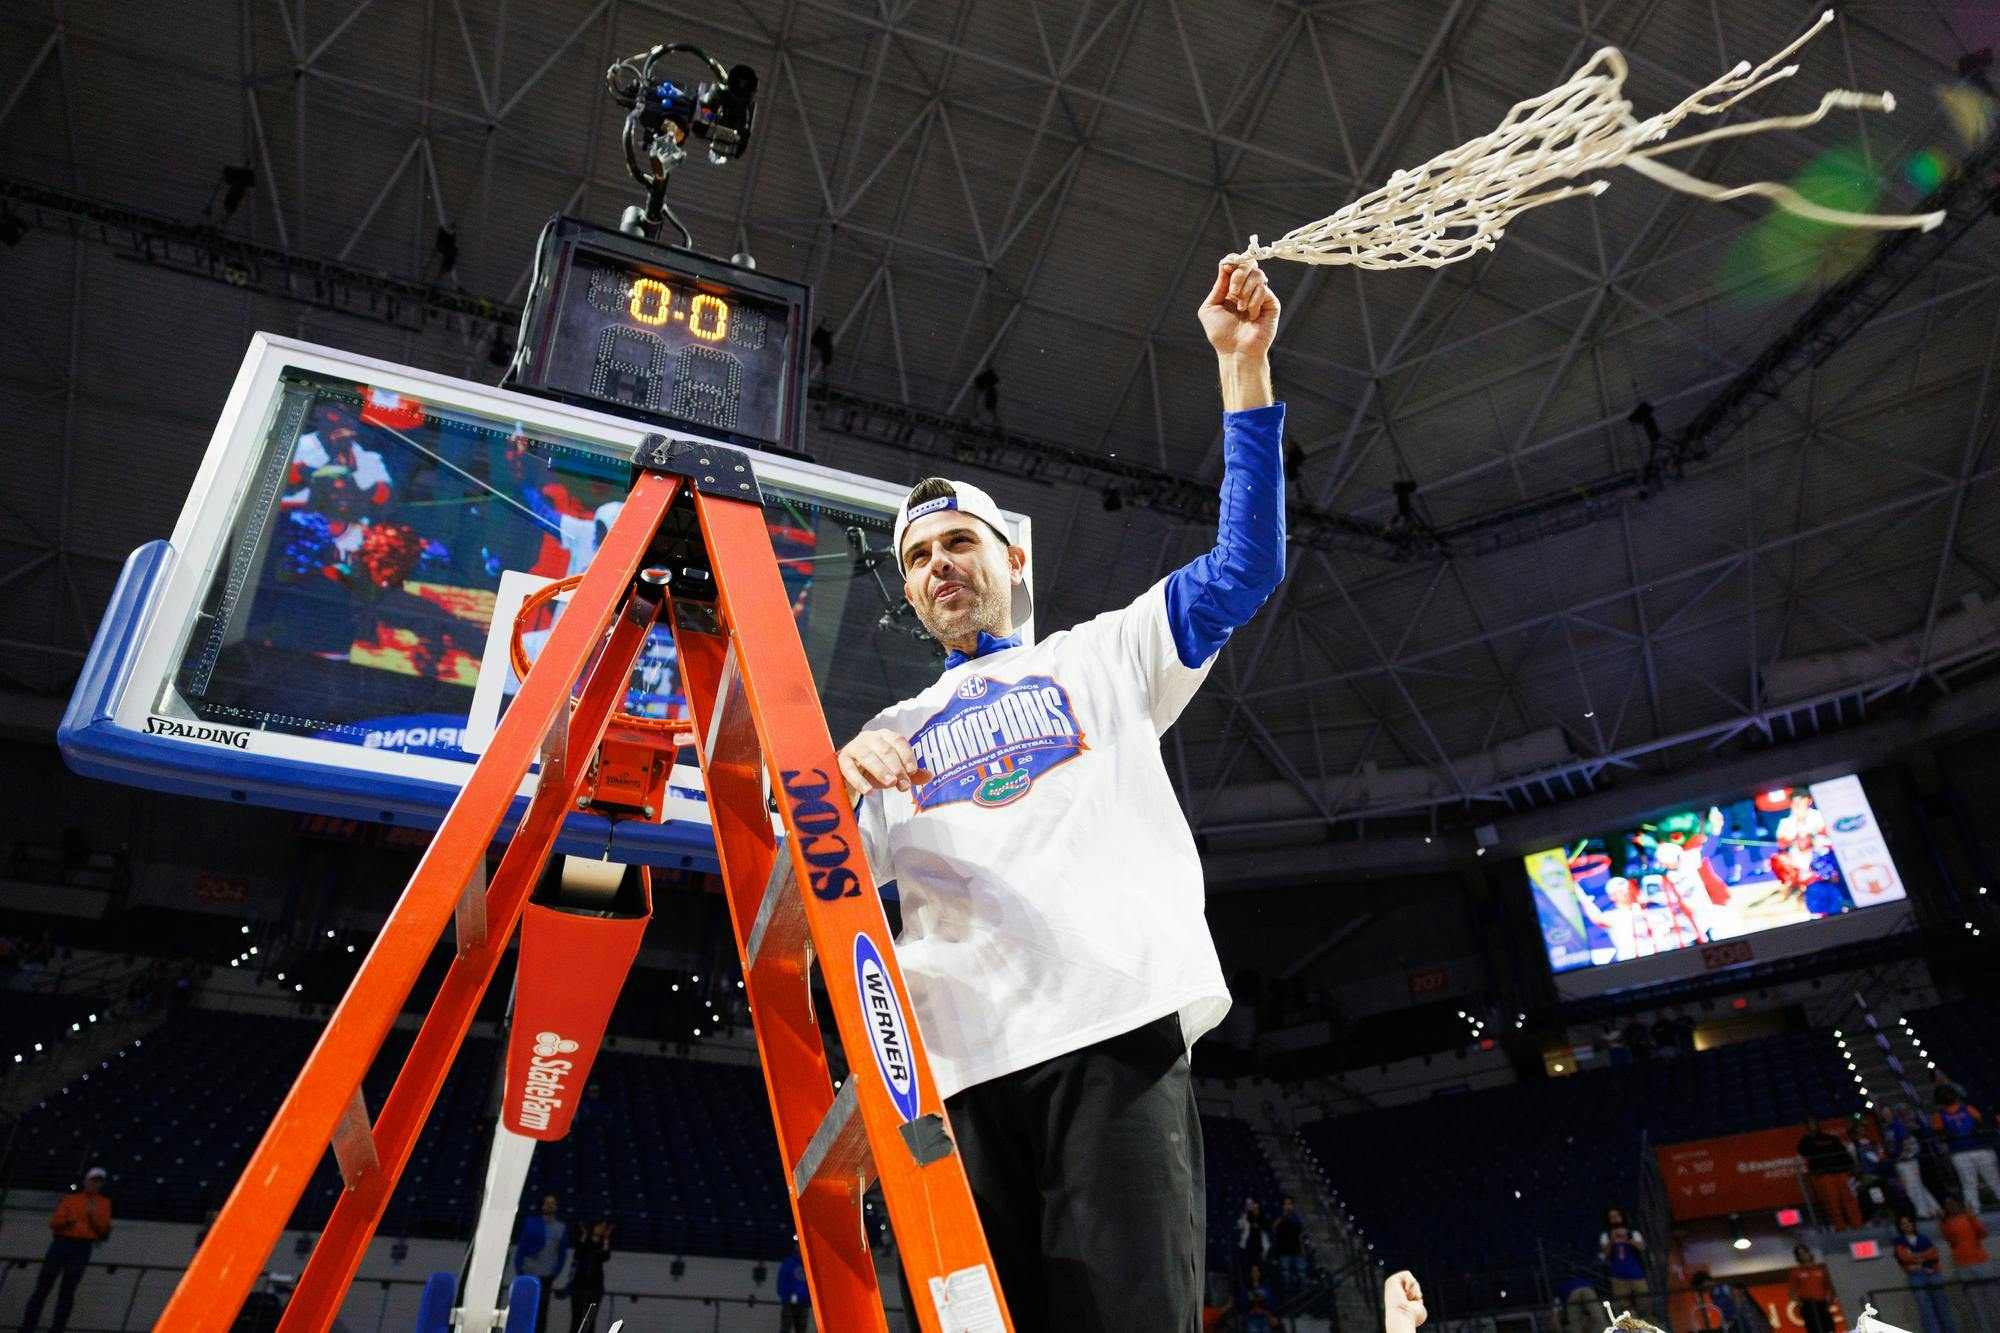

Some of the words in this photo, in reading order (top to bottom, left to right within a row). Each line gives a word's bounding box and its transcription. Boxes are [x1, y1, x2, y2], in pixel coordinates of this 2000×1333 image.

[959, 675, 986, 698] SEC
[142, 716, 251, 750] SPALDING
[932, 766, 967, 786] FLORIDA
[968, 753, 997, 767] MEN'S
[997, 739, 1056, 756] BASKETBALL
[959, 775, 976, 786] 20
[1017, 755, 1034, 765] 26
[780, 768, 862, 900] SCOC
[865, 972, 909, 1082] WERNER
